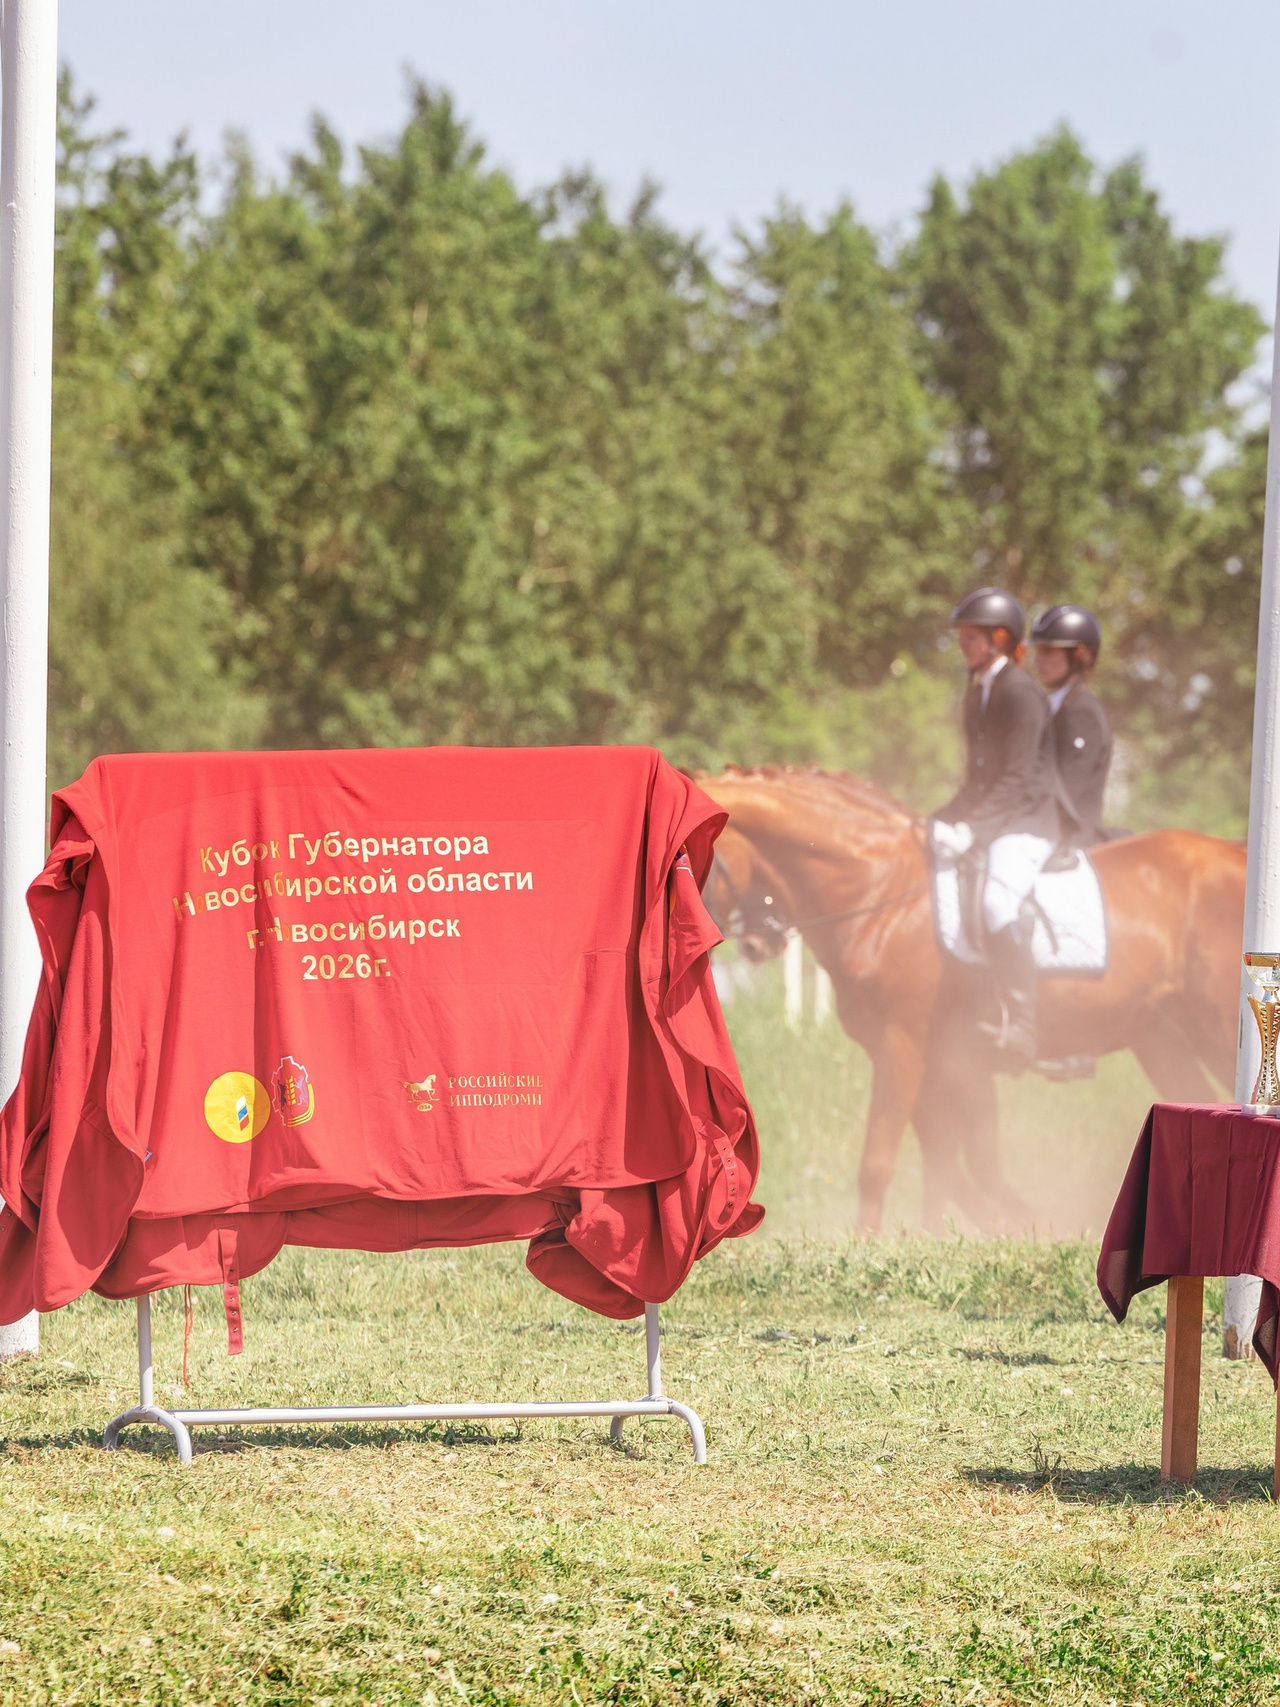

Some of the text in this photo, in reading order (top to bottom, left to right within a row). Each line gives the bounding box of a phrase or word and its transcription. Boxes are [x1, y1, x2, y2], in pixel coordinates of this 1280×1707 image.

[200, 831, 489, 877] Кубок Губернатора
[172, 867, 534, 921] Новосибирской области
[448, 1072, 543, 1089] РОССИЙСКИЕ
